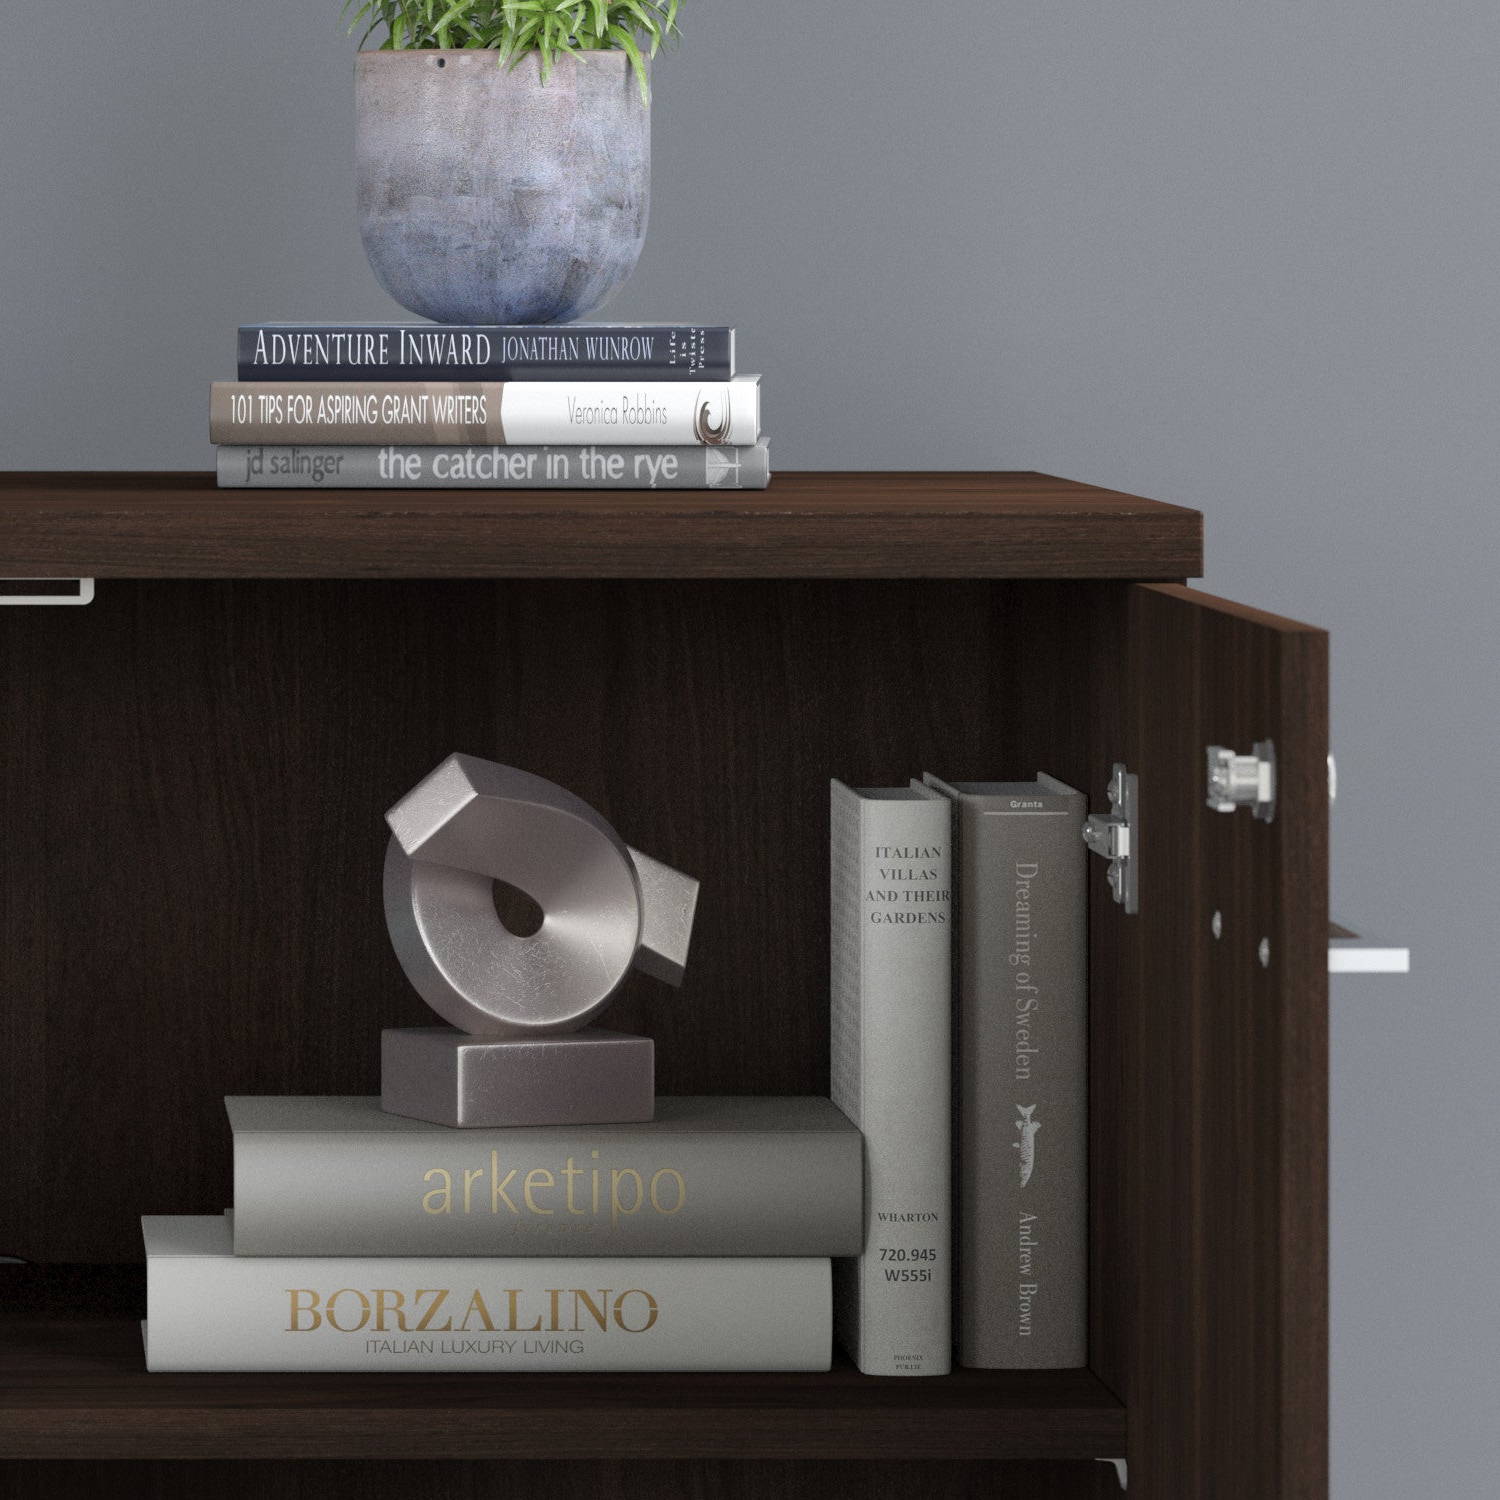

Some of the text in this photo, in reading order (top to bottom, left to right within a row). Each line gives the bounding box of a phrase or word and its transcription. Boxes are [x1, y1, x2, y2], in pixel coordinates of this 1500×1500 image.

[252, 328, 655, 366] ADVENTURE INWARD JONATHAN WUNROW
[231, 395, 487, 425] 101 TIPS FOR ASPIRING GRANT WRITERS
[567, 395, 668, 425] Veronica Robbins
[244, 448, 344, 483] jd salinger
[377, 446, 679, 486] the catcher in the rye
[1010, 800, 1043, 808] Granta
[875, 846, 942, 859] ITALIAN
[880, 868, 938, 880] VILLAS
[866, 890, 950, 902] AND THEIR
[871, 911, 946, 924] GARDENS
[1009, 862, 1038, 1080] Dreaming of Sweden
[421, 1149, 686, 1228] arketipo
[878, 1212, 939, 1223] WHARTON
[879, 1248, 937, 1262] 720.945
[884, 1268, 932, 1282] W555i
[1019, 1211, 1038, 1336] Andrew Brown
[284, 1288, 659, 1333] BORZALINO
[365, 1340, 585, 1354] ITALIAN LUXURY LIVING
